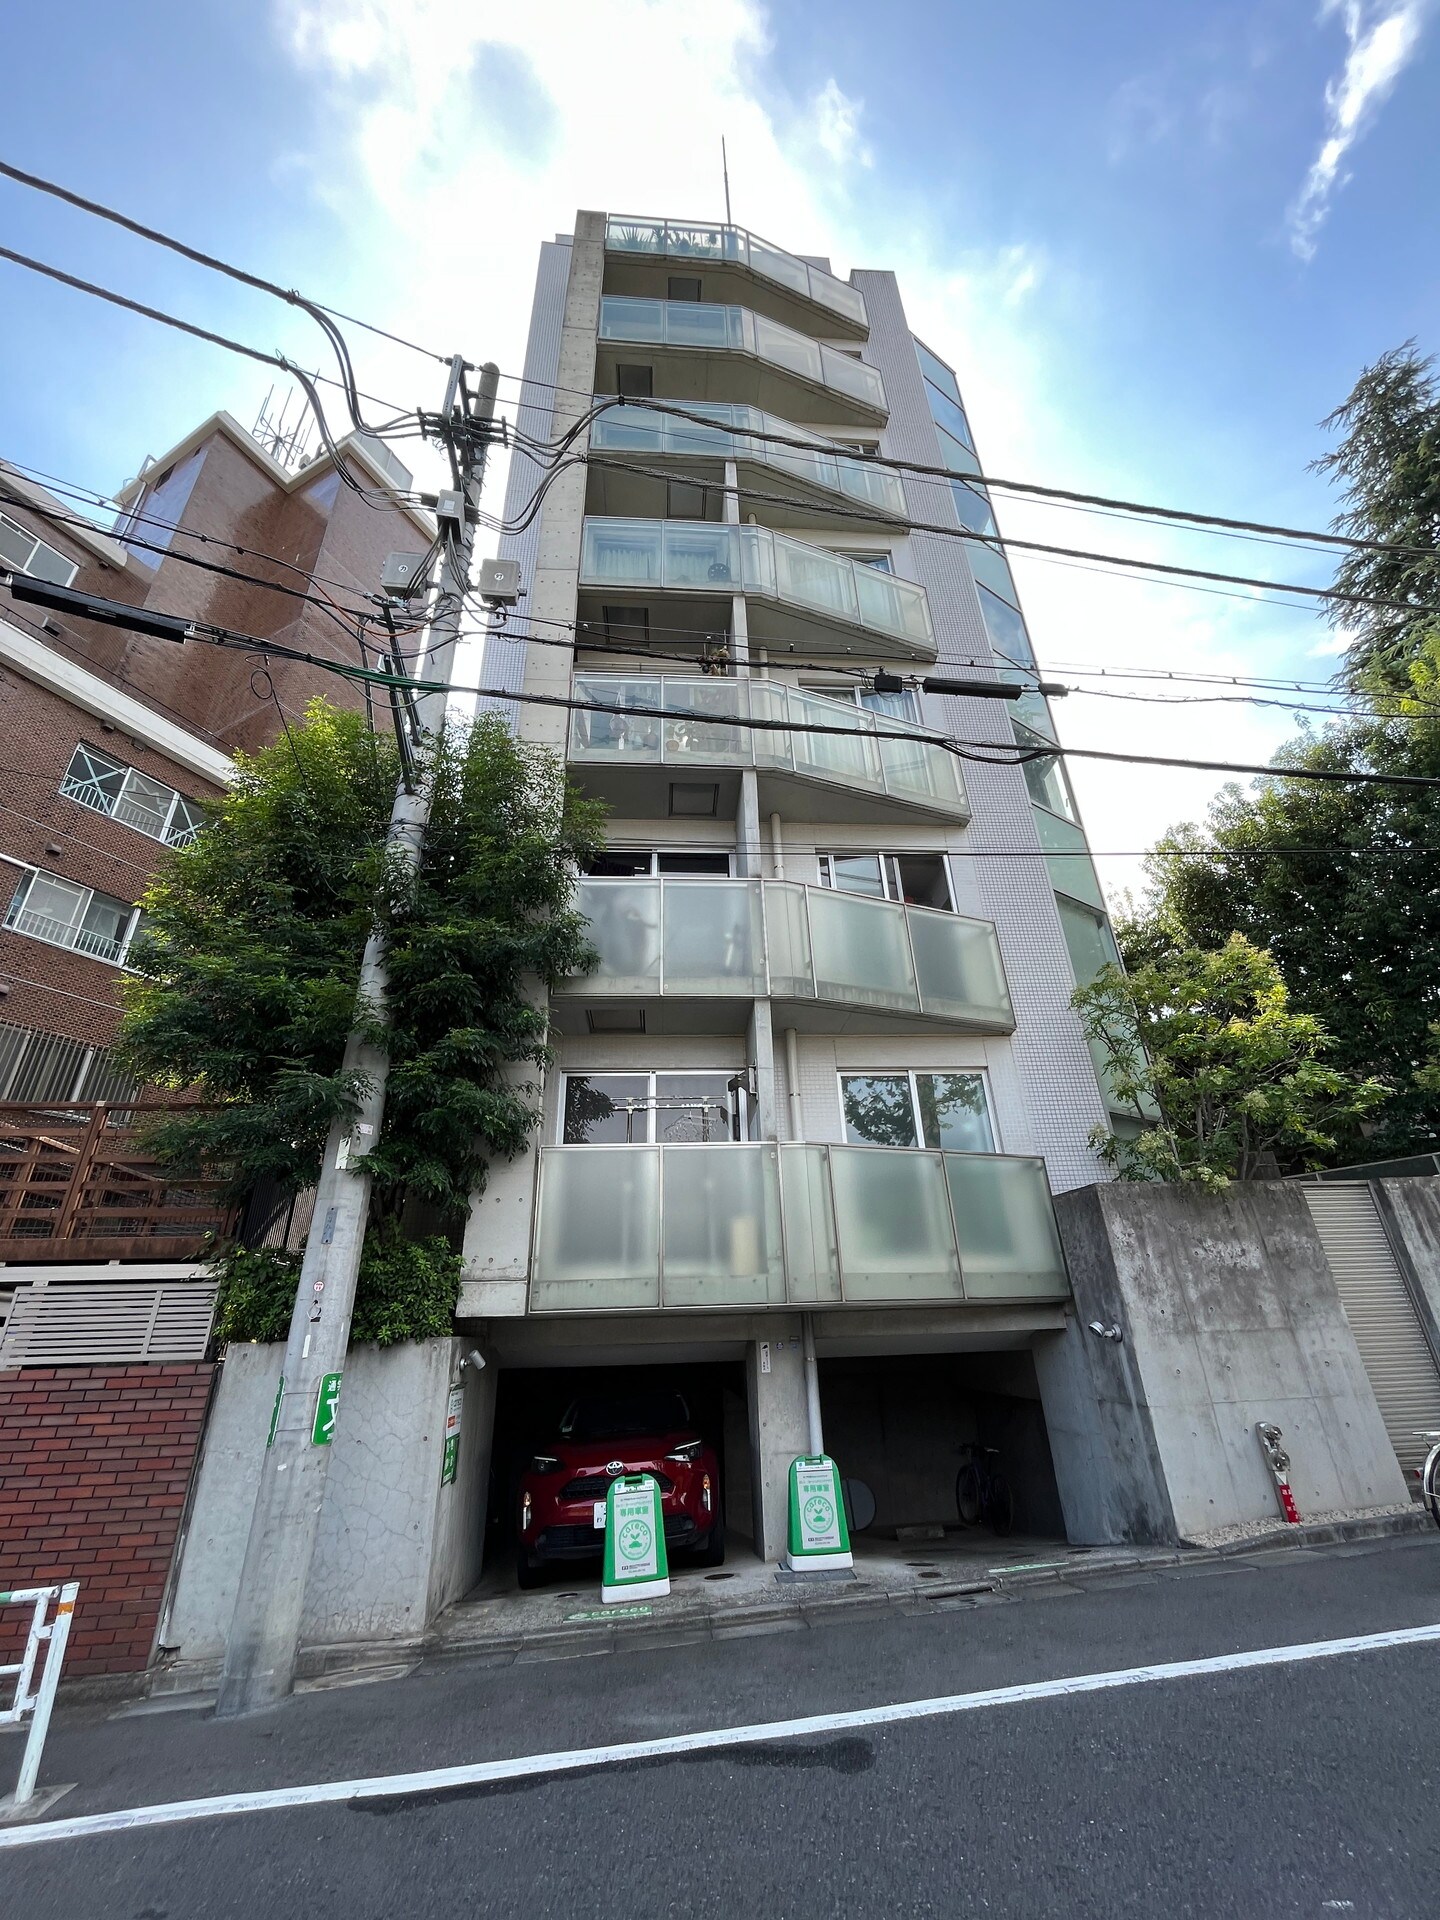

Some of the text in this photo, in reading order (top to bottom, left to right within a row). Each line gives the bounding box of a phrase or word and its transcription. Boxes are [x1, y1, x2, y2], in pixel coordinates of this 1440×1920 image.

[806, 1499, 831, 1513] careco
[622, 1523, 648, 1539] careco
[591, 1606, 648, 1617] careco
